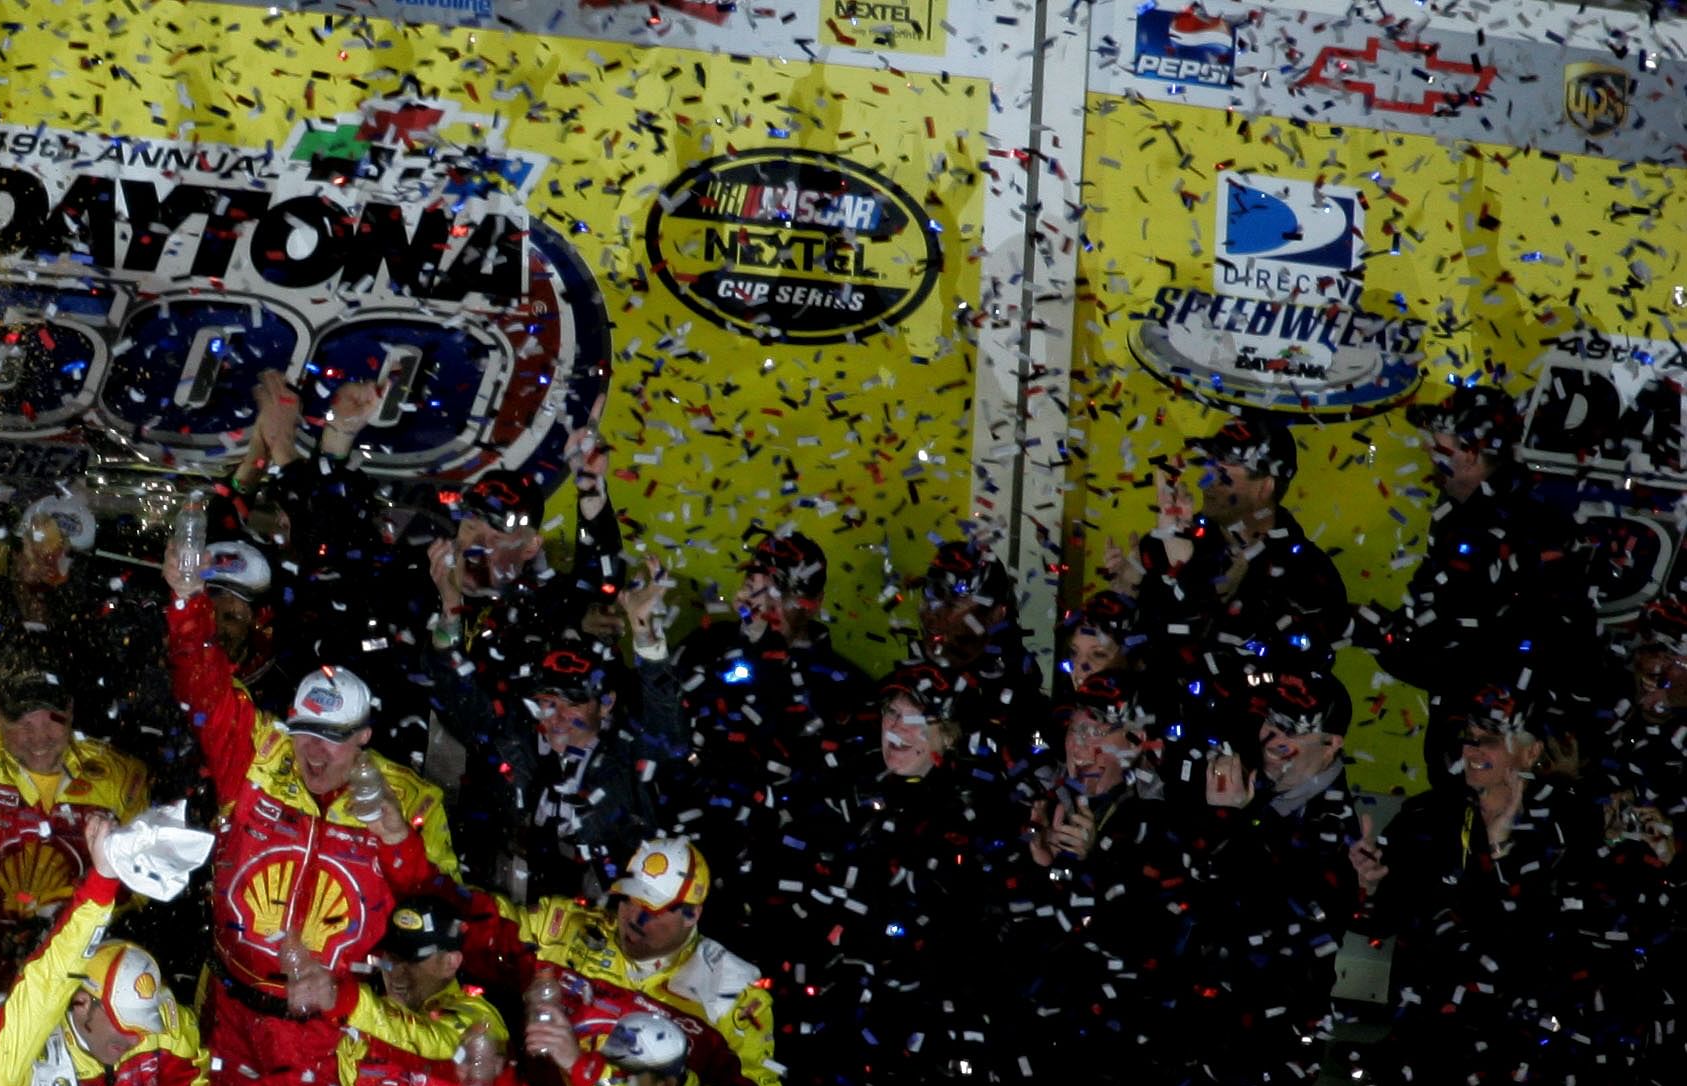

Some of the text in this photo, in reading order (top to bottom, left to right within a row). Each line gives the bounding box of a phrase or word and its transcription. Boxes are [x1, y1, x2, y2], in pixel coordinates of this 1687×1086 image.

[1135, 54, 1232, 86] PEPSI
[1569, 82, 1626, 130] ups
[103, 142, 277, 176] ANNUAL
[761, 182, 879, 230] NASCAR
[705, 228, 882, 278] NEXTEL
[717, 279, 769, 303] CUP
